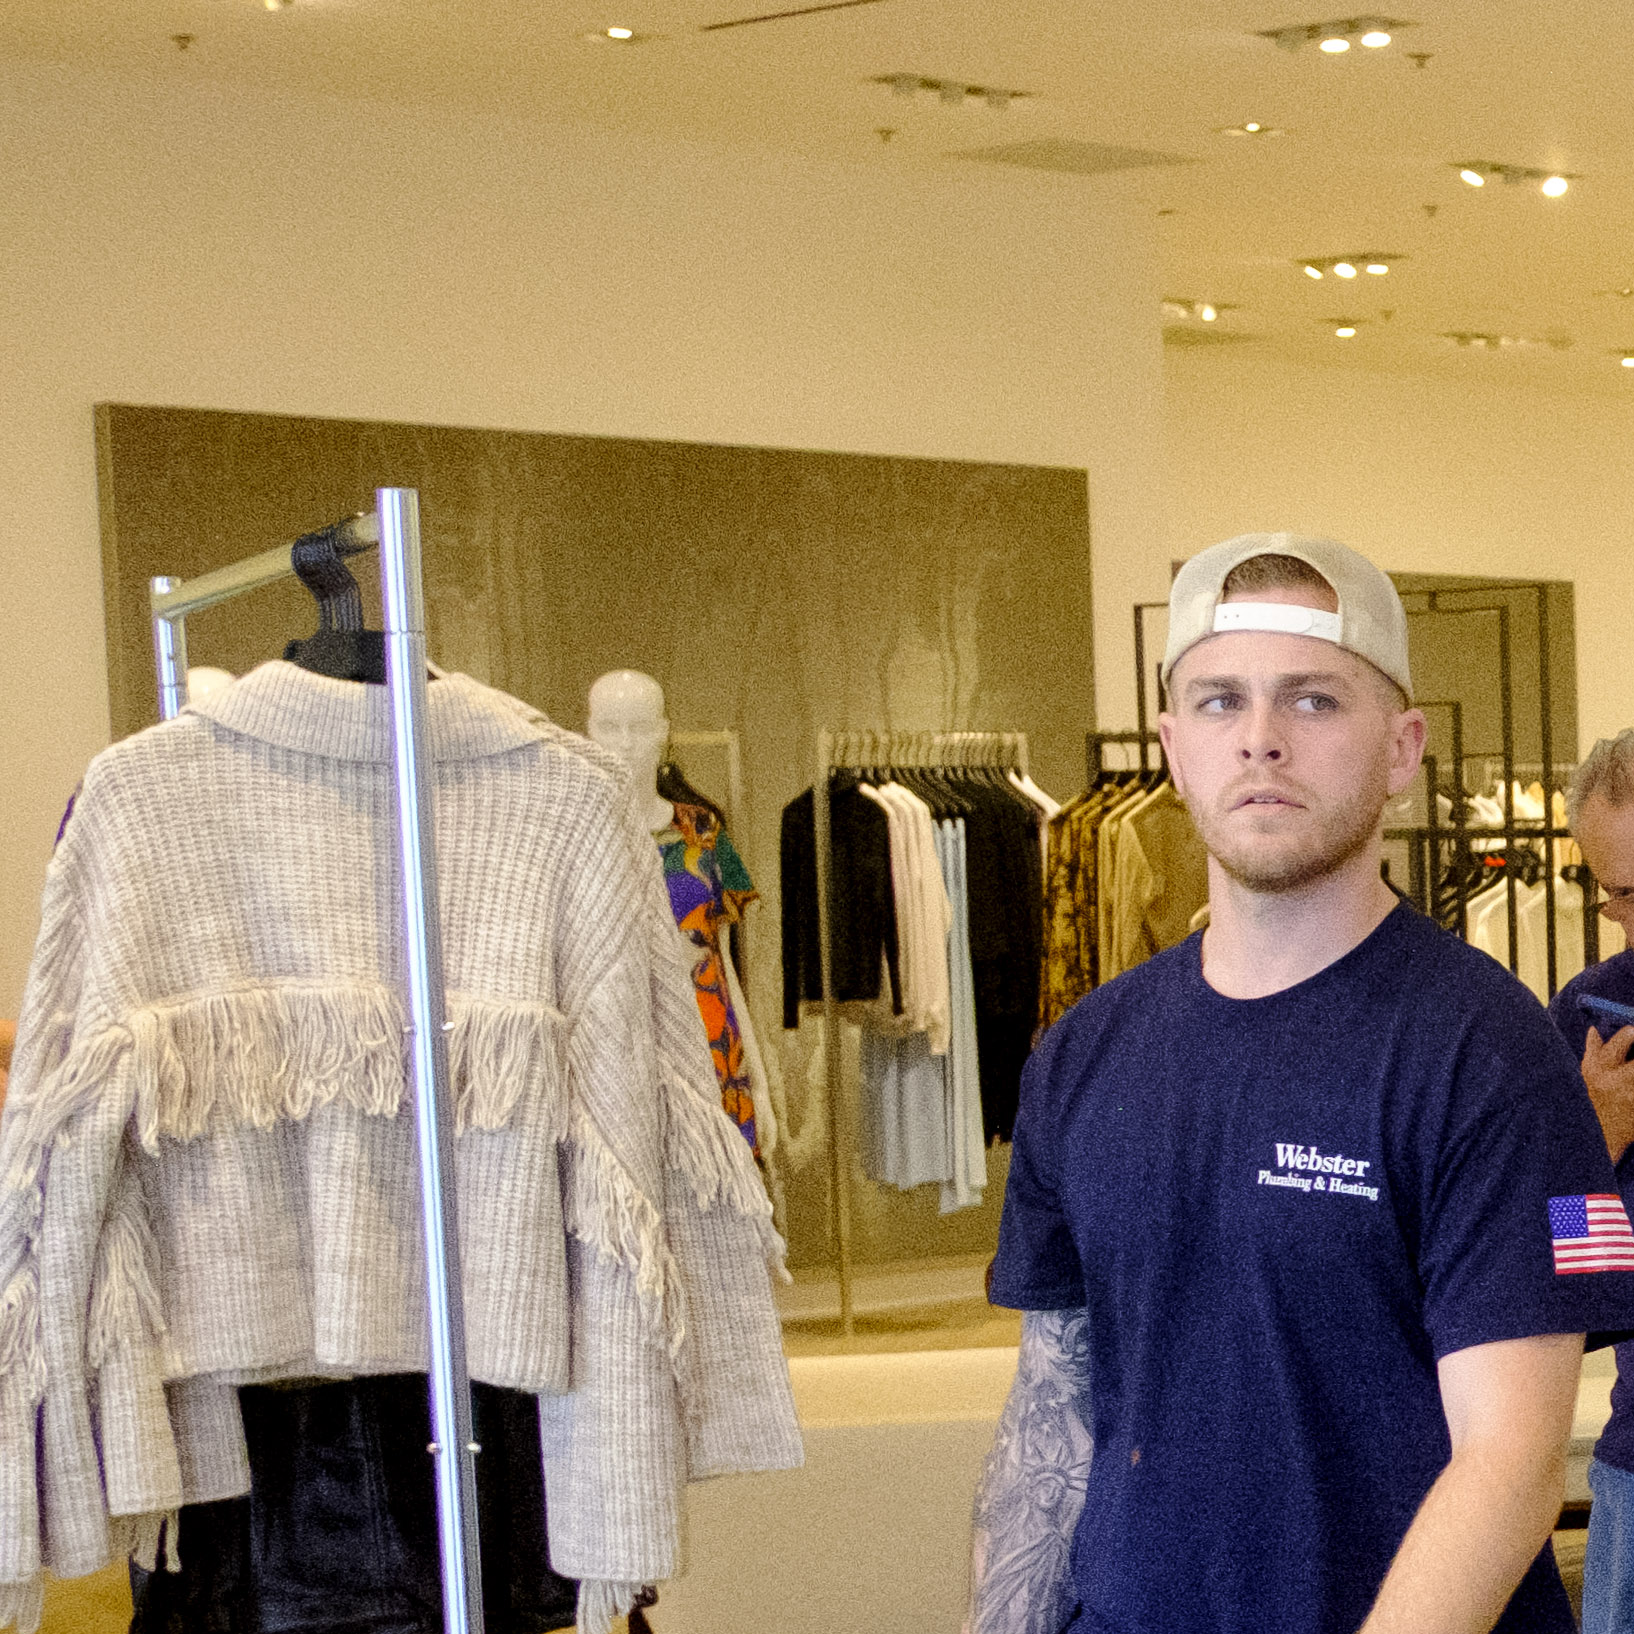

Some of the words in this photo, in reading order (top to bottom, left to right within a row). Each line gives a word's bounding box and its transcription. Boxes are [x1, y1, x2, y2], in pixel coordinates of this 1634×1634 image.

[1275, 1143, 1370, 1177] Webster
[1257, 1170, 1312, 1192] Plumbing
[1313, 1176, 1326, 1190] &
[1329, 1177, 1379, 1201] Heating
